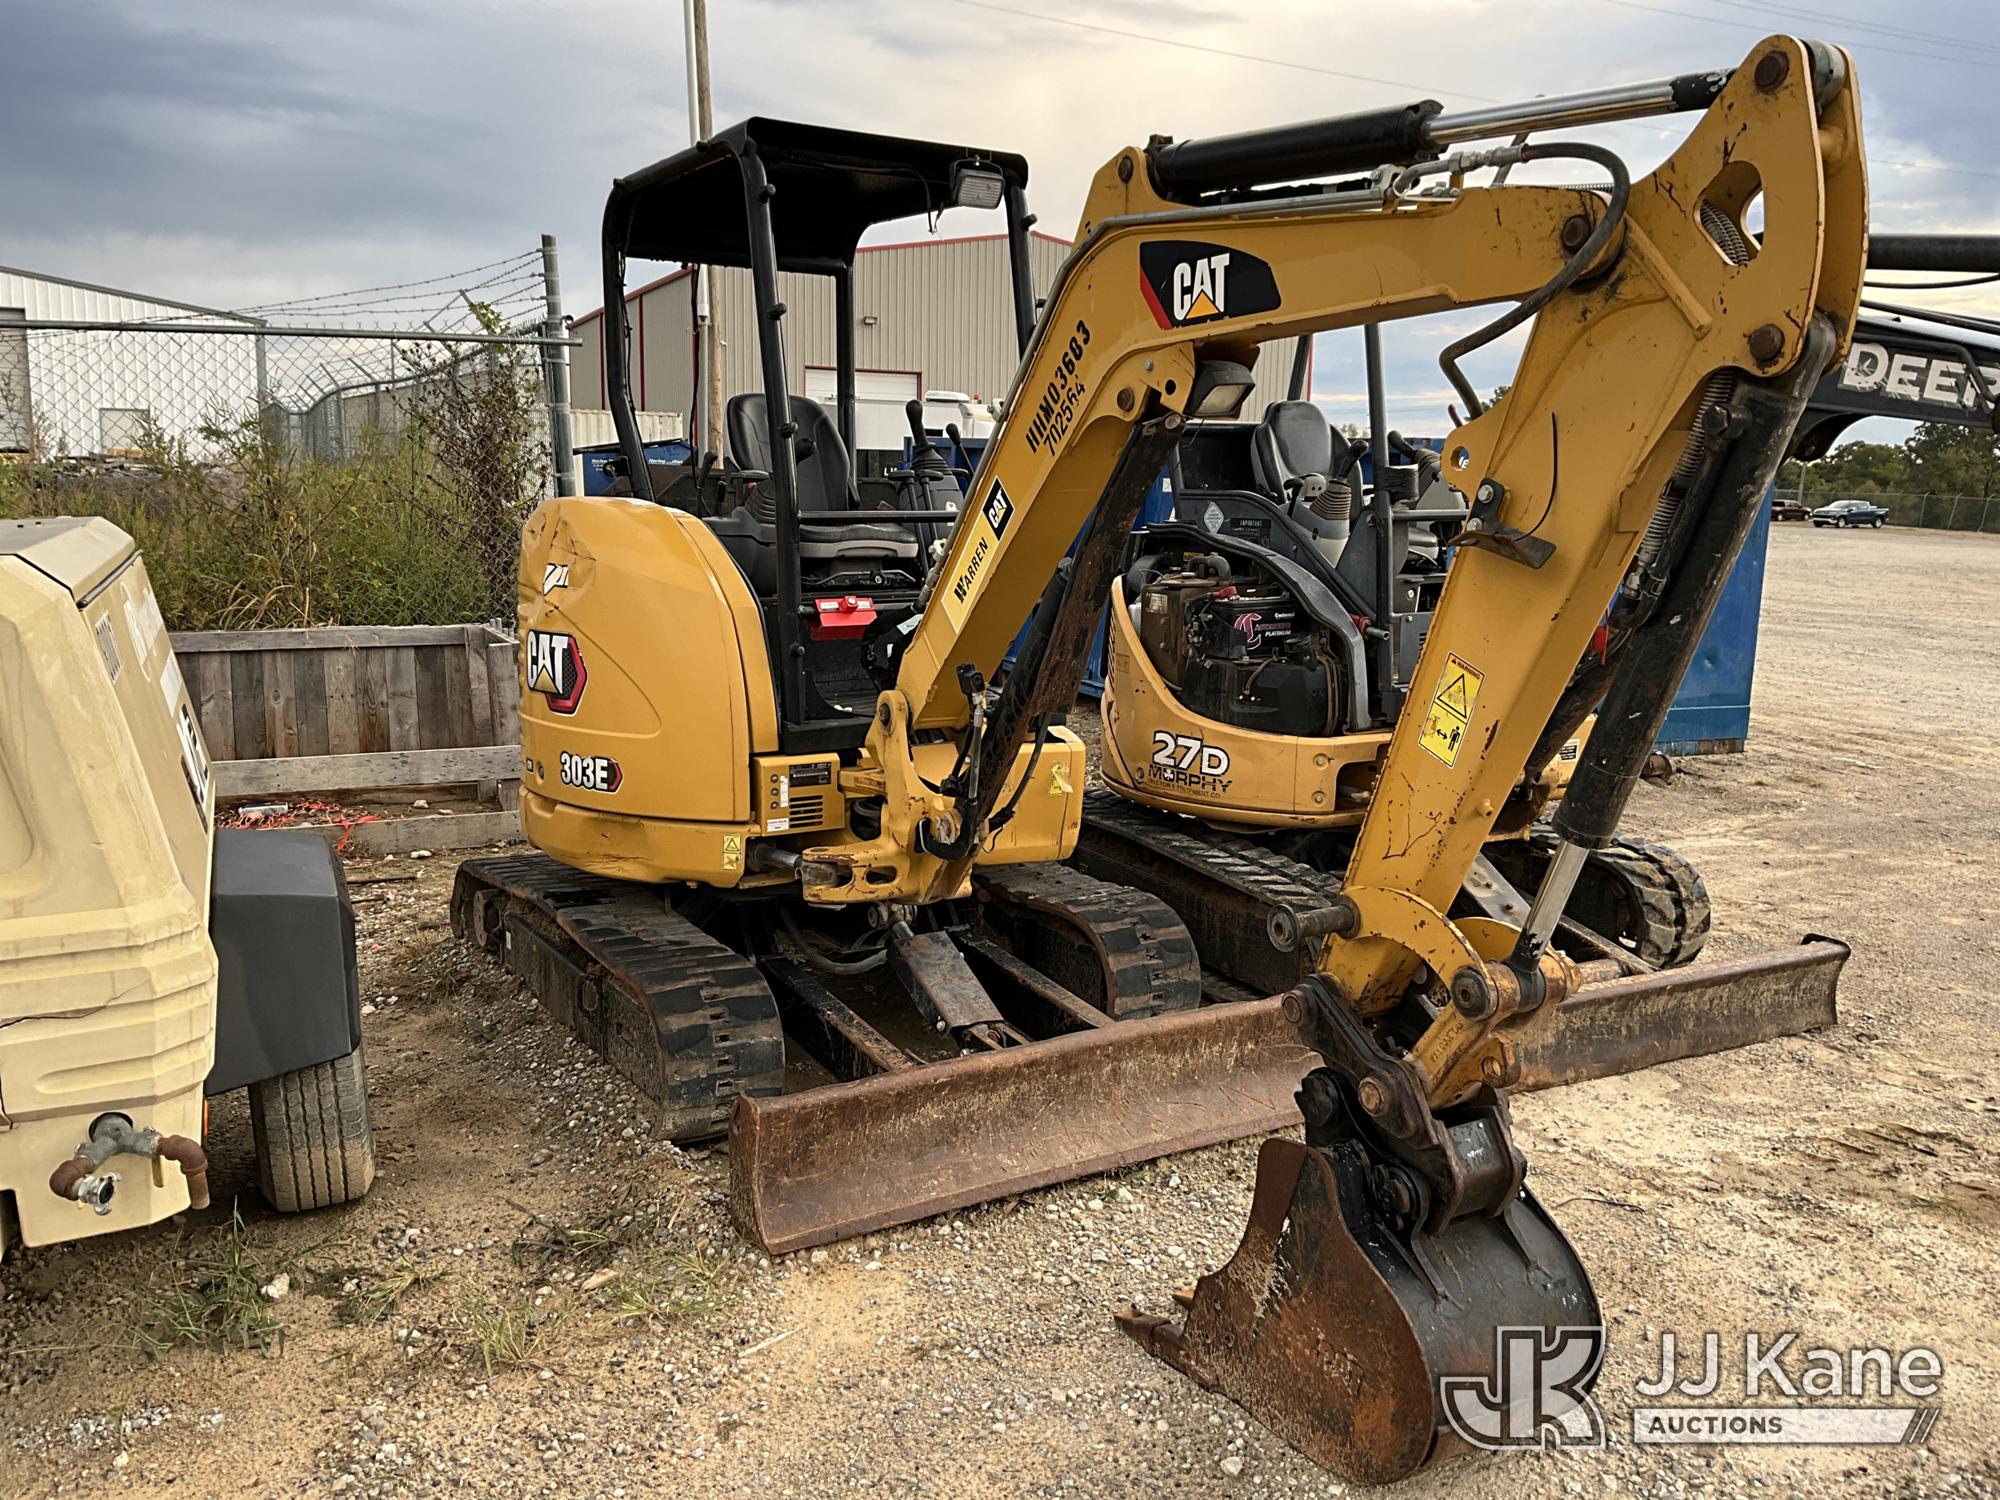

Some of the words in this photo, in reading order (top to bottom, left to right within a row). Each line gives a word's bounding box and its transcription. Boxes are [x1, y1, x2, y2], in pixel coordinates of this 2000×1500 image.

[1173, 252, 1230, 320] CAT
[988, 488, 1008, 529] CAT
[953, 536, 989, 605] WARREN
[527, 630, 569, 696] CAT
[1456, 661, 1481, 681] WARNING
[560, 750, 609, 791] 303E
[1152, 730, 1230, 777] 27D
